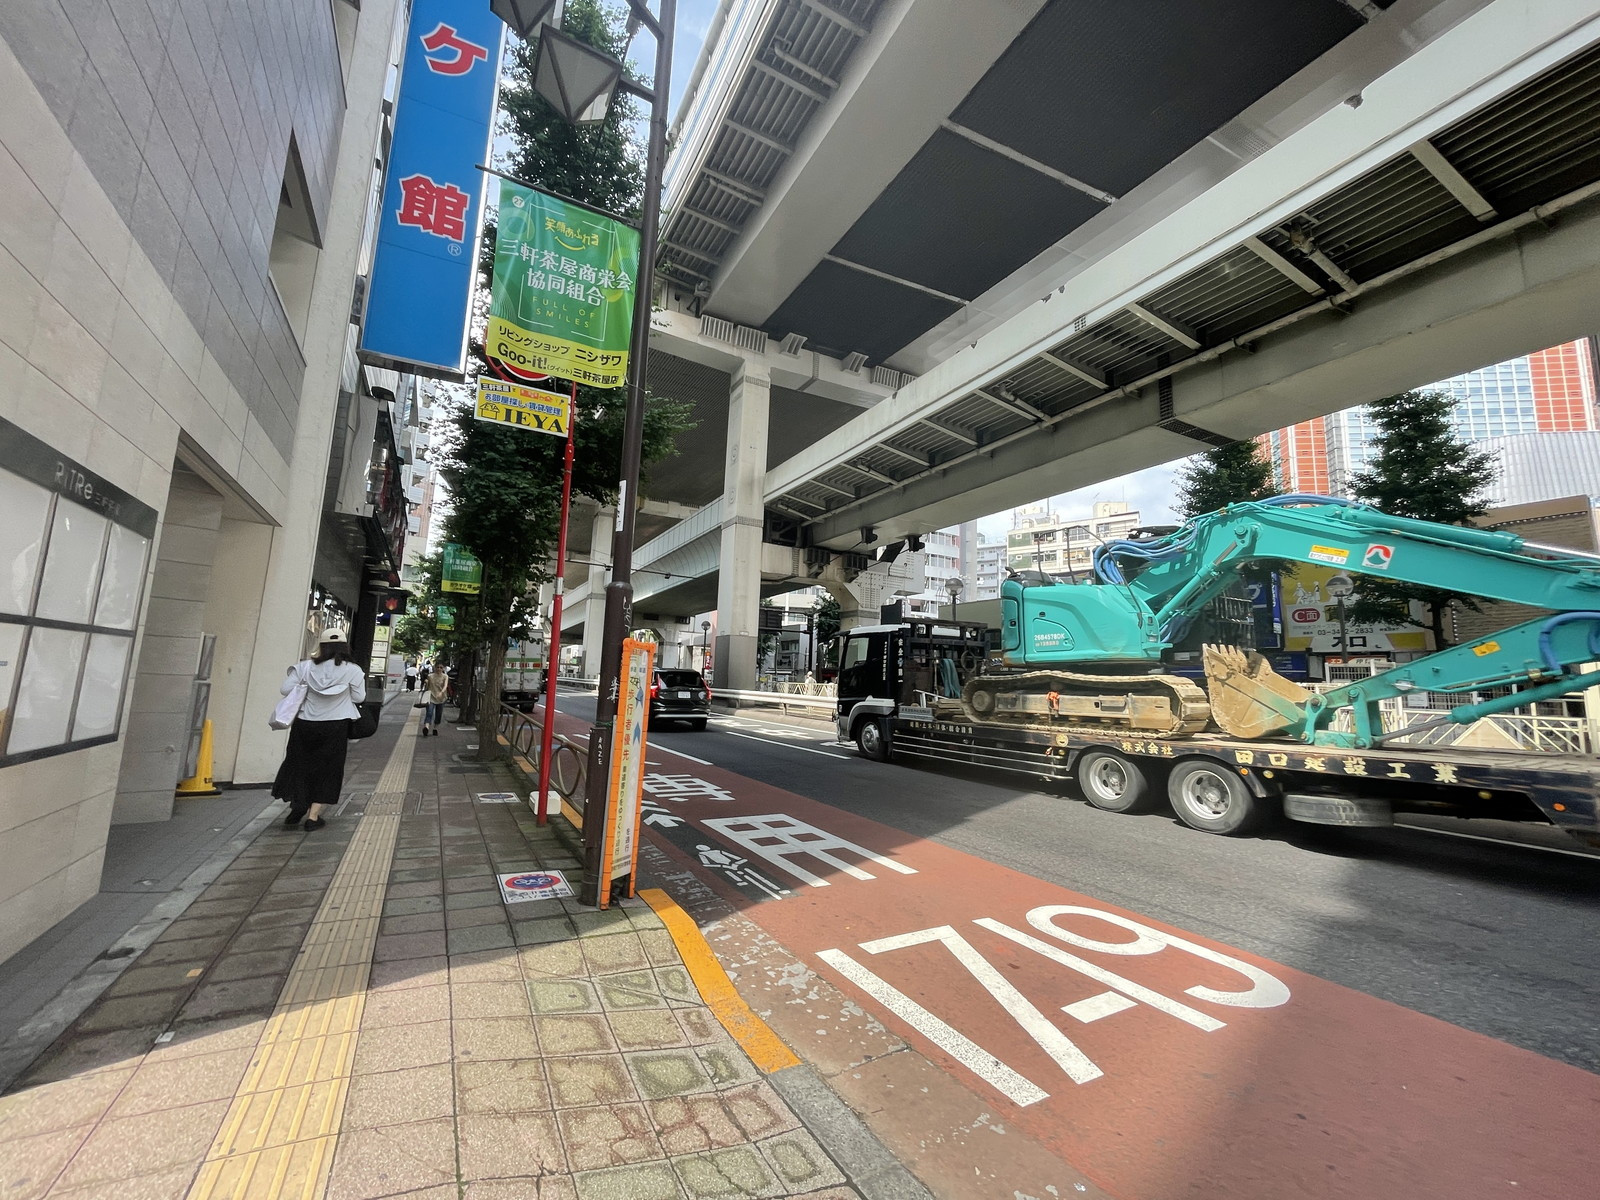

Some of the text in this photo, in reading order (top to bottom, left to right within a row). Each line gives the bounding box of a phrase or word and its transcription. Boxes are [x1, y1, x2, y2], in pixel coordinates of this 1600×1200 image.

[513, 198, 523, 206] 27
[499, 239, 633, 290] 三軒茶屋商栄会
[527, 268, 606, 306] 協同組合
[533, 296, 596, 319] FULL OF
[536, 308, 590, 328] SMILES
[497, 343, 547, 370] Goo-it!
[573, 367, 620, 385] 三軒茶屋店
[499, 326, 622, 367] リビングショップ ニシザワ
[504, 408, 564, 433] IEYA
[1317, 627, 1373, 636] 03-342-2833
[622, 690, 635, 761] 歩行者優先
[1121, 740, 1458, 784] 株式会社 田口建設工業
